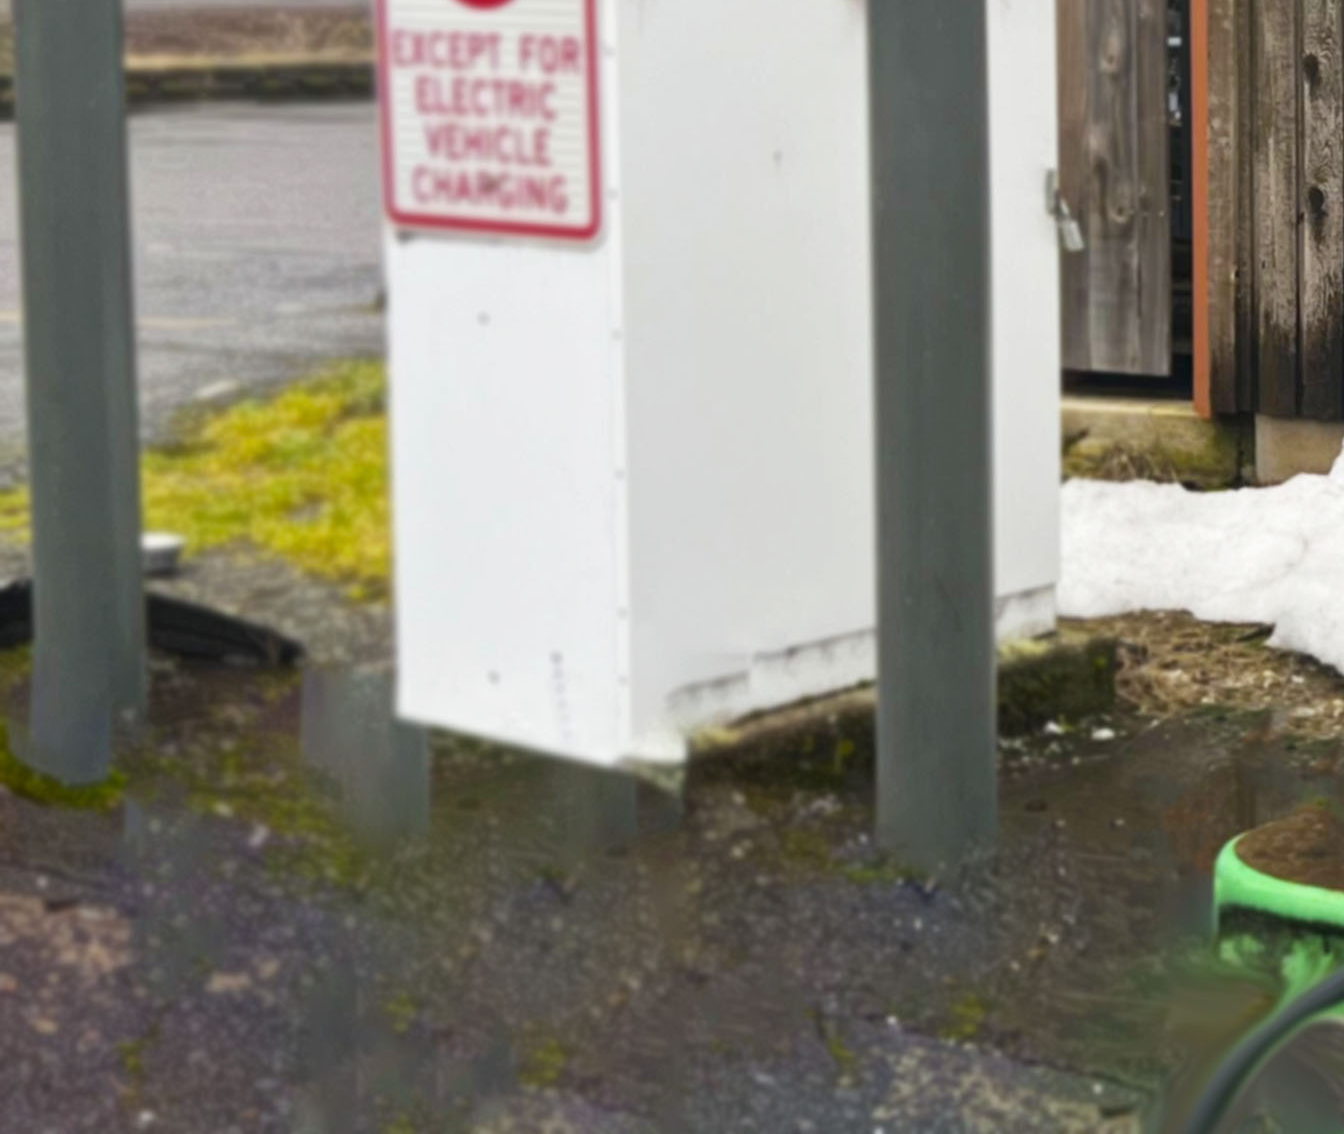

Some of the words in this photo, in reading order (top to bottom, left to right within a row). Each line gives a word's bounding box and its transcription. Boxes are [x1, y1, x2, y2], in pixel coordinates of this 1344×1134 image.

[392, 29, 501, 70] EXCEPT
[517, 32, 580, 75] FOR
[414, 74, 557, 123] ELECTRIC
[423, 122, 552, 168] VEHICLE
[412, 165, 568, 215] CHARGING
